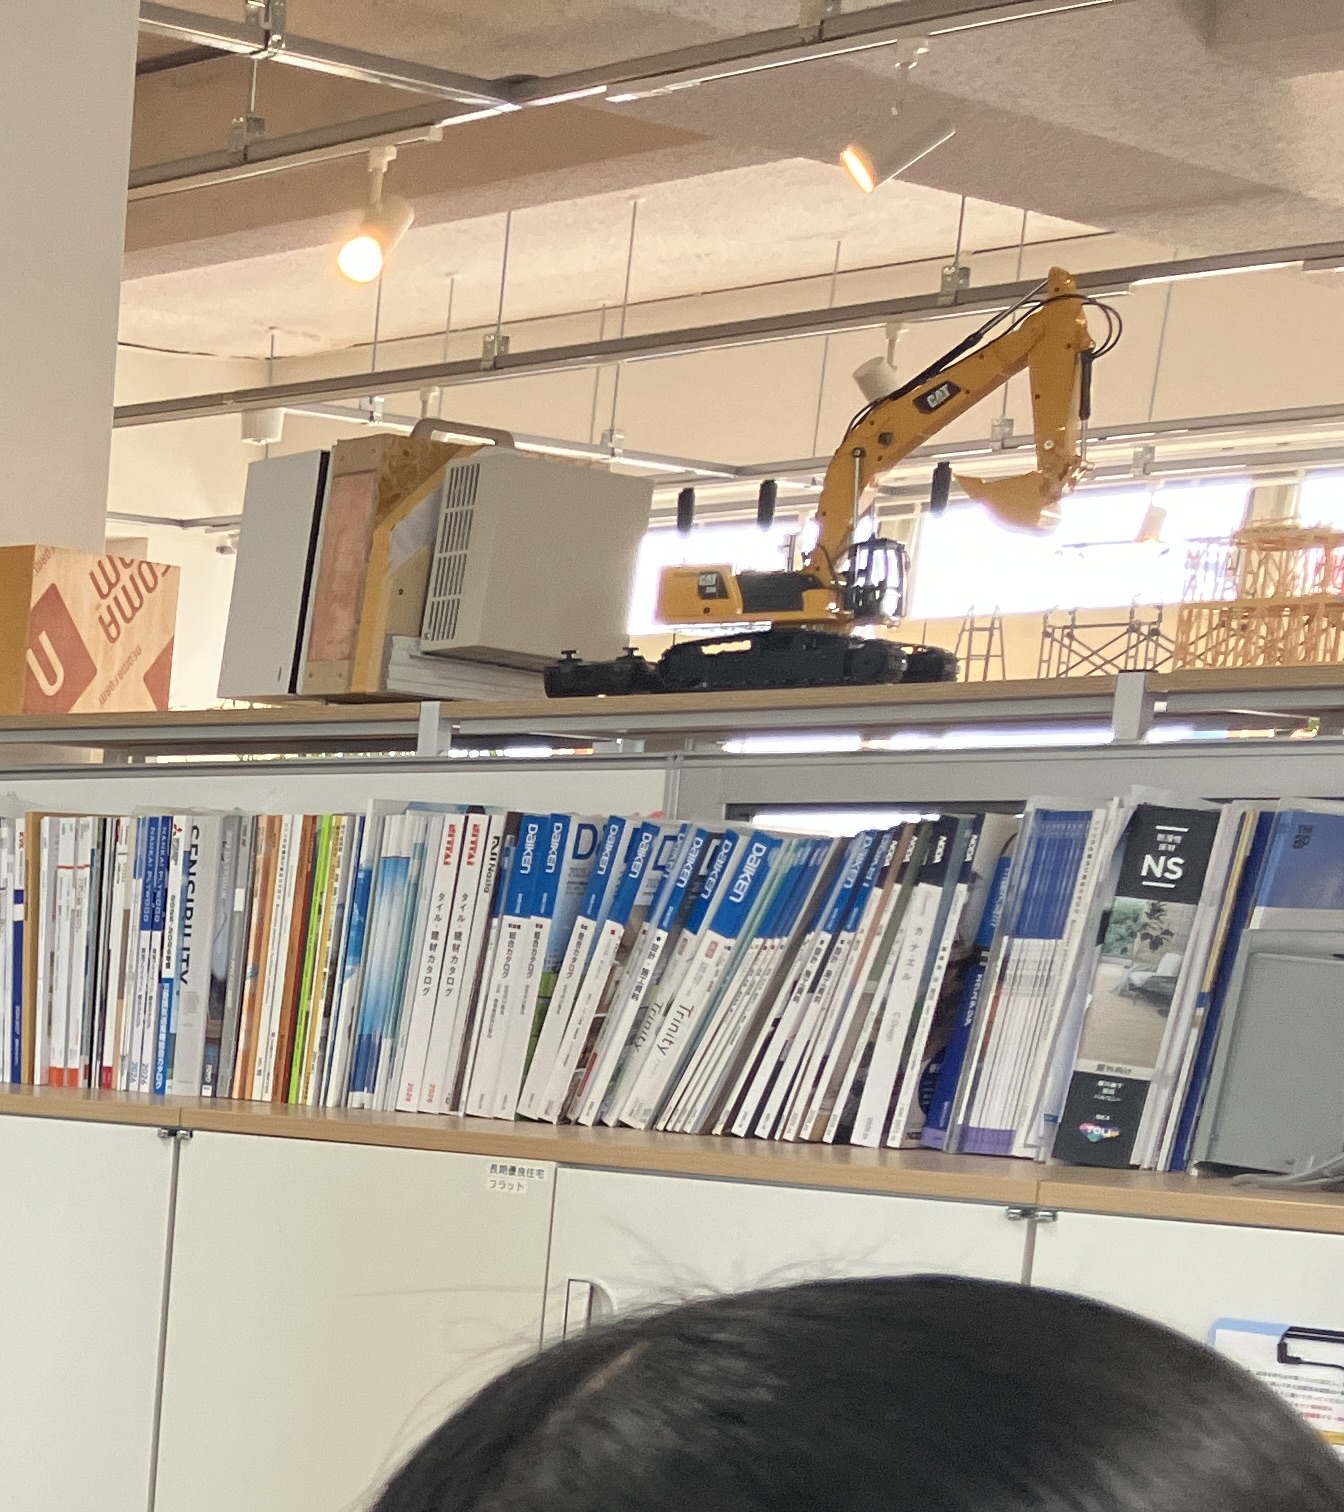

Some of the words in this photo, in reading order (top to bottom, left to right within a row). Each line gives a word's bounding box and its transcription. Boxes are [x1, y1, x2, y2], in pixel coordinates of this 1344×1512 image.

[925, 384, 952, 409] CAT
[1141, 854, 1185, 880] NS
[657, 1005, 695, 1056] Trinity
[489, 1163, 545, 1180] 長期優良住宅
[489, 1179, 525, 1191] フラット
